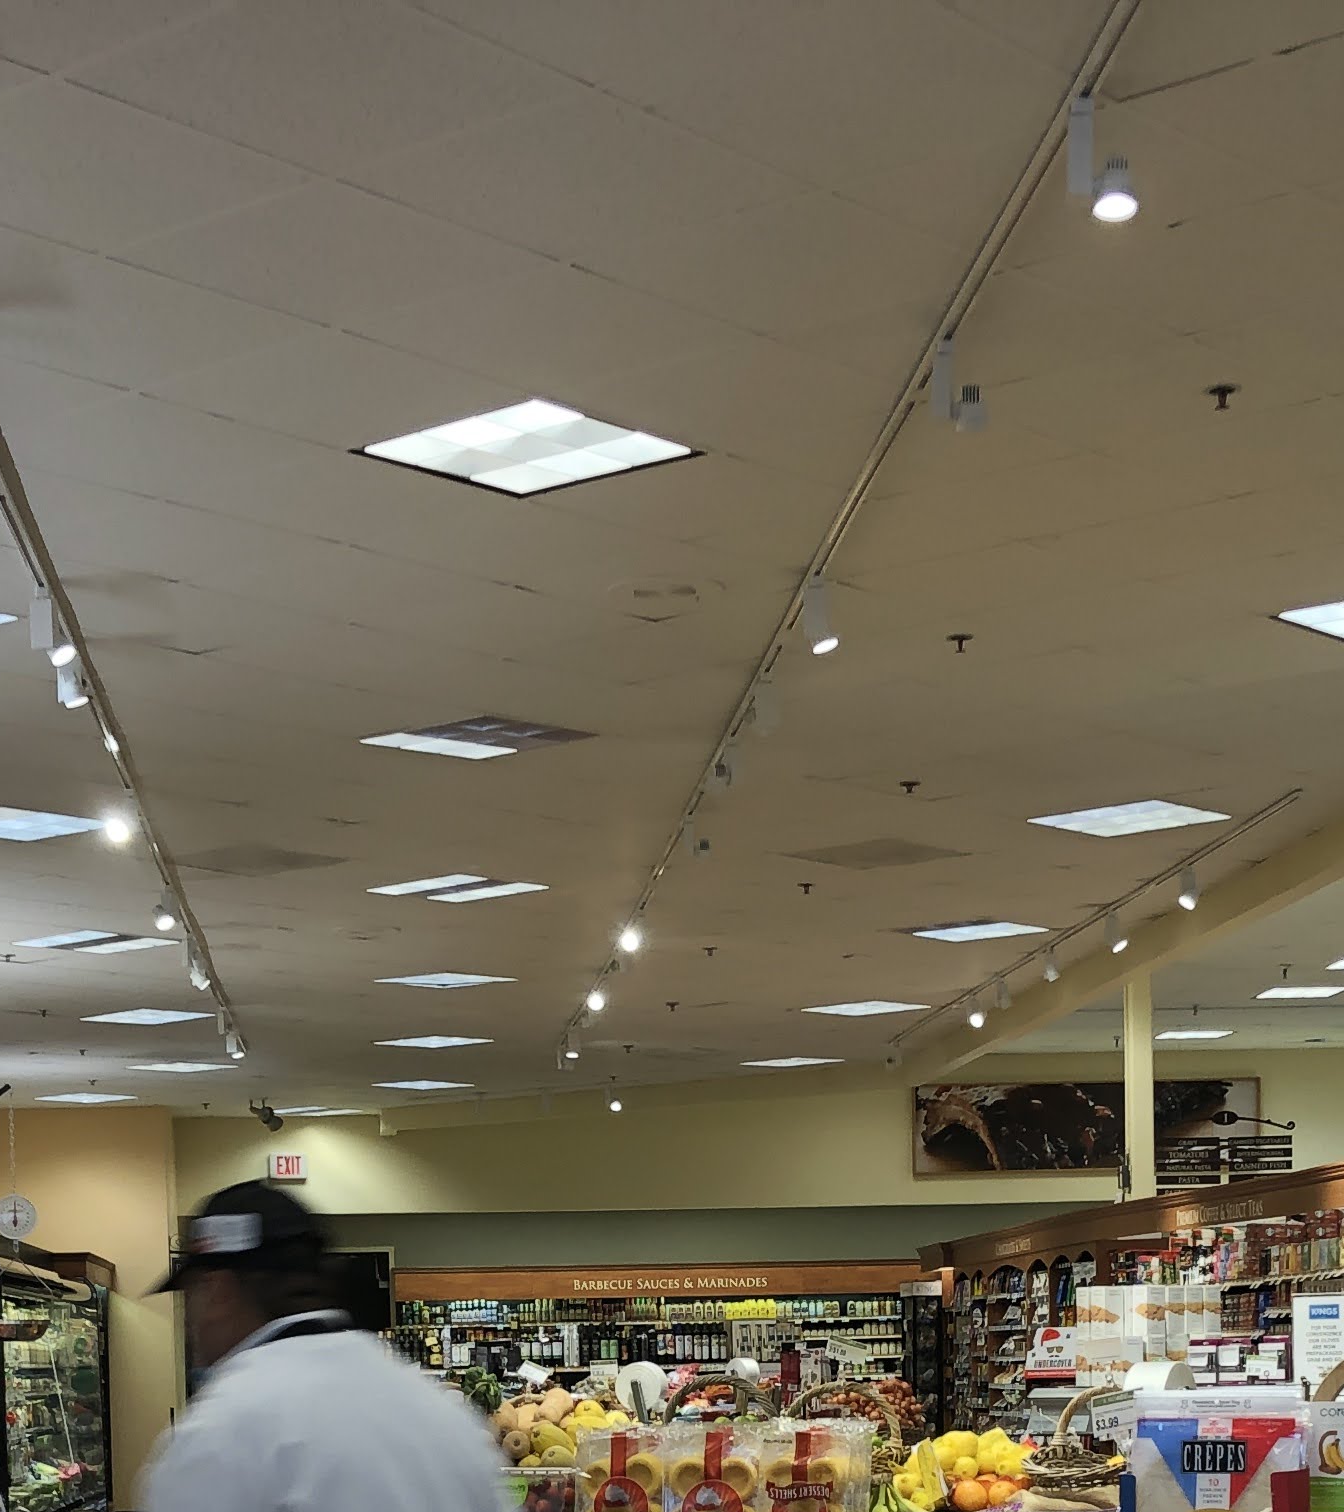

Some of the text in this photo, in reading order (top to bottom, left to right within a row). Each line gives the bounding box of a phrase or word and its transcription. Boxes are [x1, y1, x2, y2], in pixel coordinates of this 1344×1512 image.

[276, 1155, 302, 1176] EXIT
[1178, 1176, 1201, 1184] PASTA
[573, 1276, 768, 1291] BARBECUE SAUCES & MARINADES
[1310, 1306, 1338, 1317] KINGS
[1095, 1416, 1119, 1432] $3.99
[1182, 1442, 1246, 1472] CRÊPES
[1207, 1478, 1220, 1487] 10
